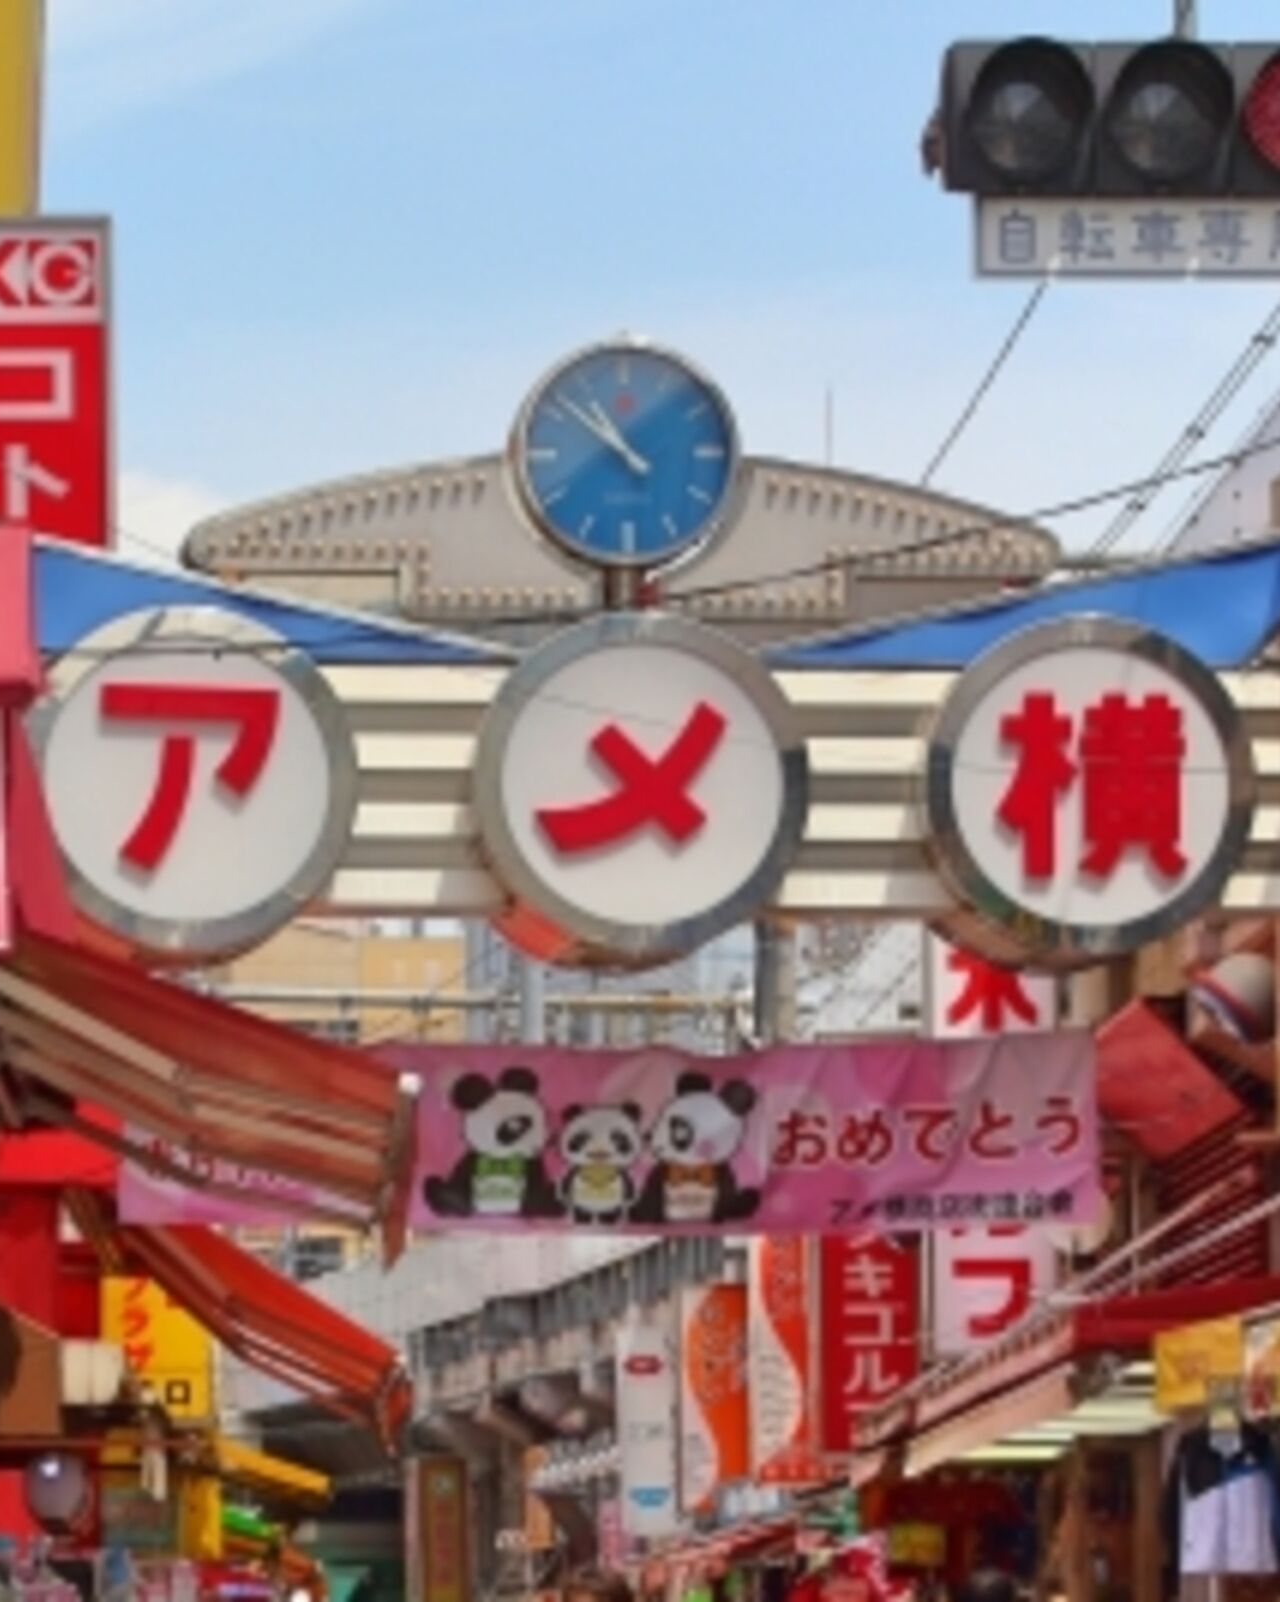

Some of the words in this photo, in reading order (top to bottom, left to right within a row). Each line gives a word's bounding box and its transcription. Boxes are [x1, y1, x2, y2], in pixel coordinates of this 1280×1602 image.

[100, 680, 1190, 885] アメ横
[773, 1096, 1081, 1166] おめでとう
